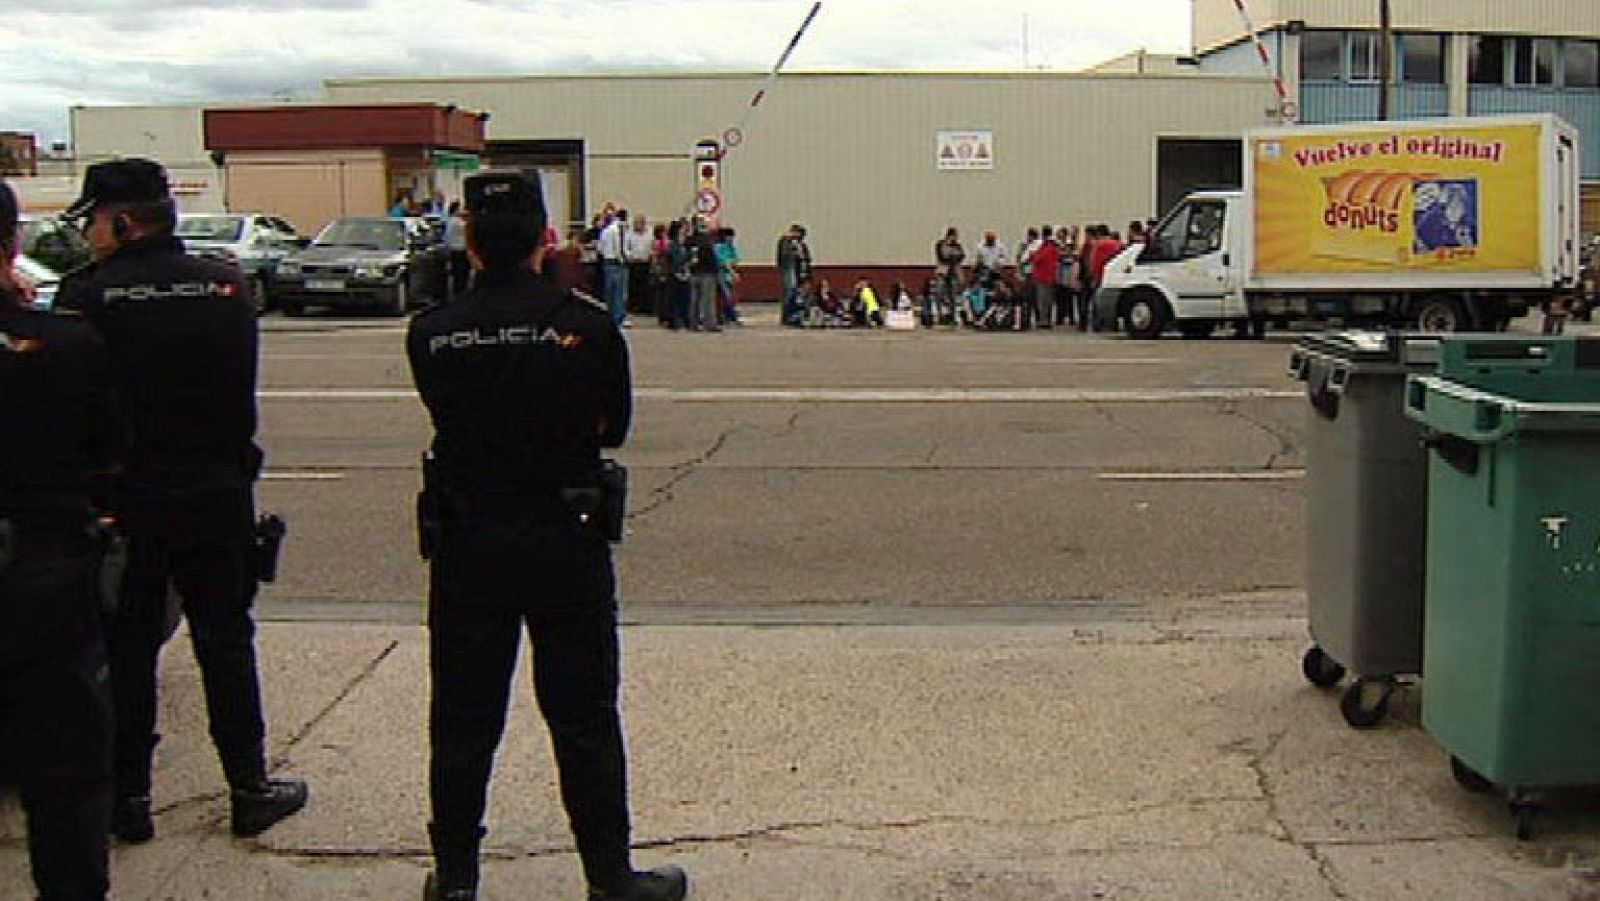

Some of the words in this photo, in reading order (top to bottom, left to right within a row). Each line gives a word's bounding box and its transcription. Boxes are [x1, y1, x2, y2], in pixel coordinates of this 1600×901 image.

[1294, 141, 1372, 167] Vuelve
[1378, 135, 1399, 155] el
[1406, 135, 1501, 162] original
[1324, 201, 1399, 233] donuts
